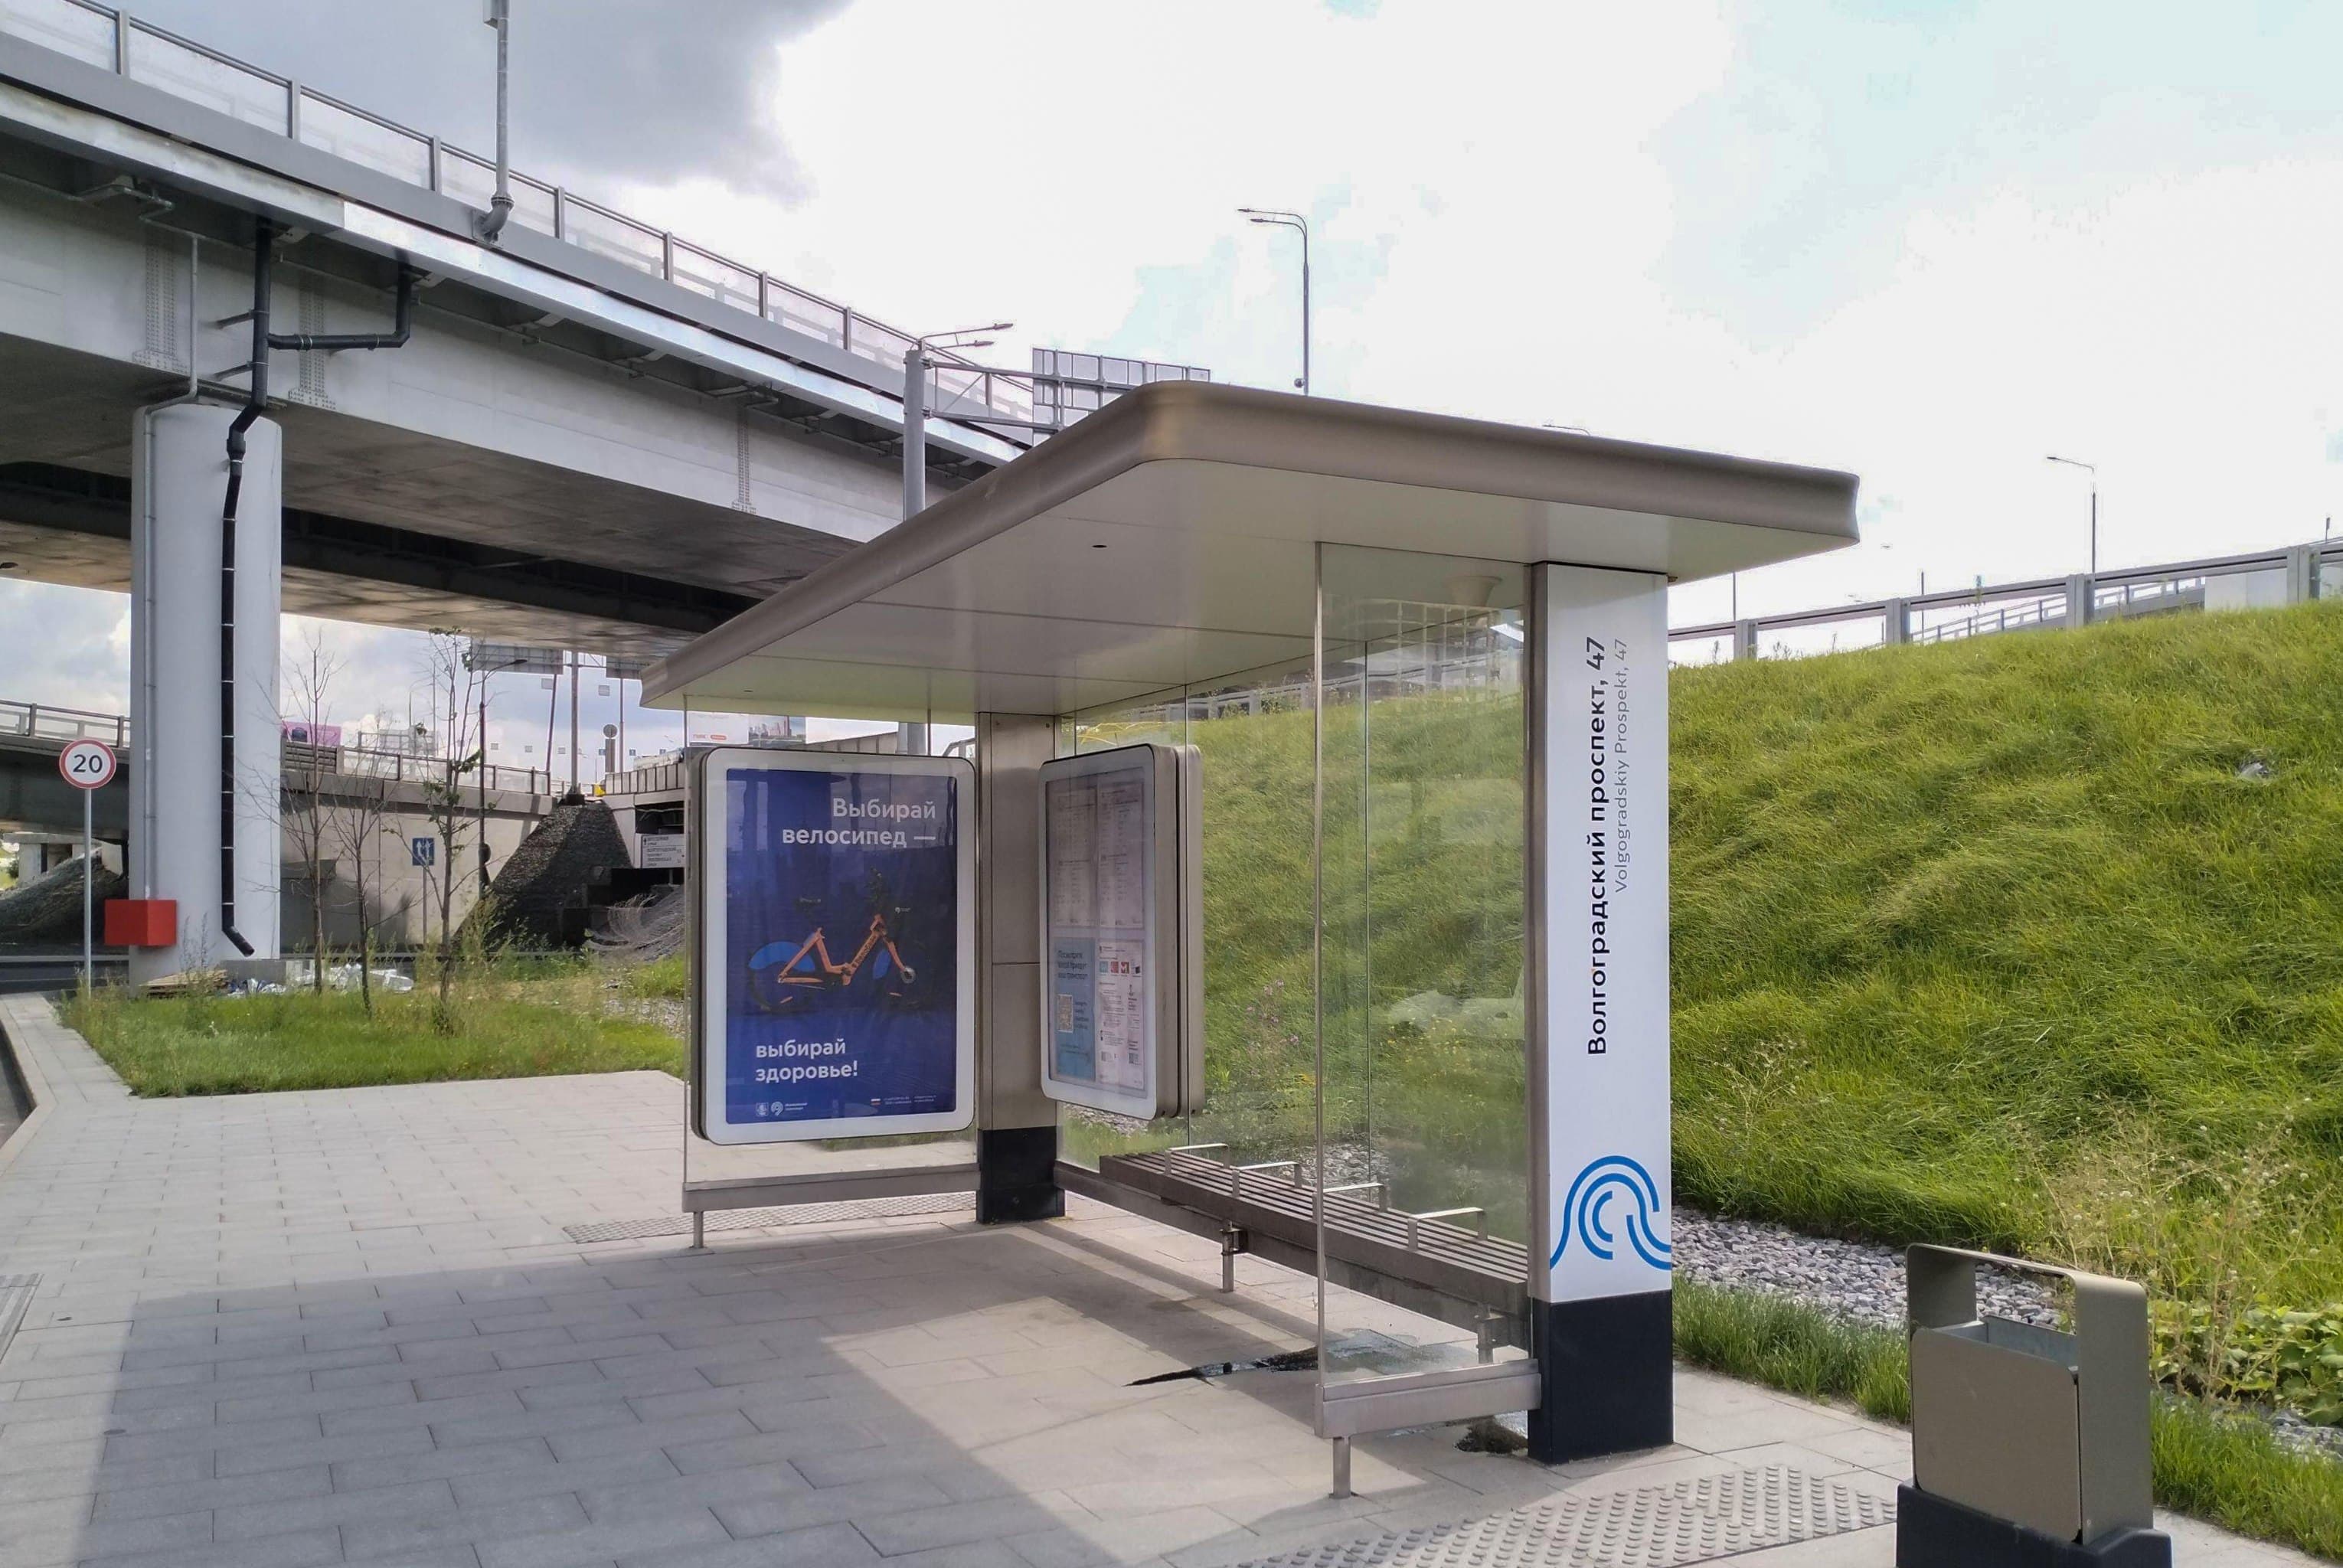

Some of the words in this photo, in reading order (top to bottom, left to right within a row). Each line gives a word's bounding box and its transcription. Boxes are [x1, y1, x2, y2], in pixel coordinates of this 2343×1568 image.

[1587, 637, 1605, 671] 47
[1614, 639, 1627, 661] 47
[1614, 667, 1629, 753] Prospekt,
[1591, 680, 1609, 822] проспект,
[73, 754, 103, 773] 20
[833, 798, 936, 822] Выбирай
[783, 829, 907, 848] велосипед
[1614, 760, 1630, 893] Volgogradskiy
[1587, 831, 1609, 1054] Волгоградский
[756, 1038, 846, 1060] выбирай
[755, 1060, 858, 1083] здоровье!
